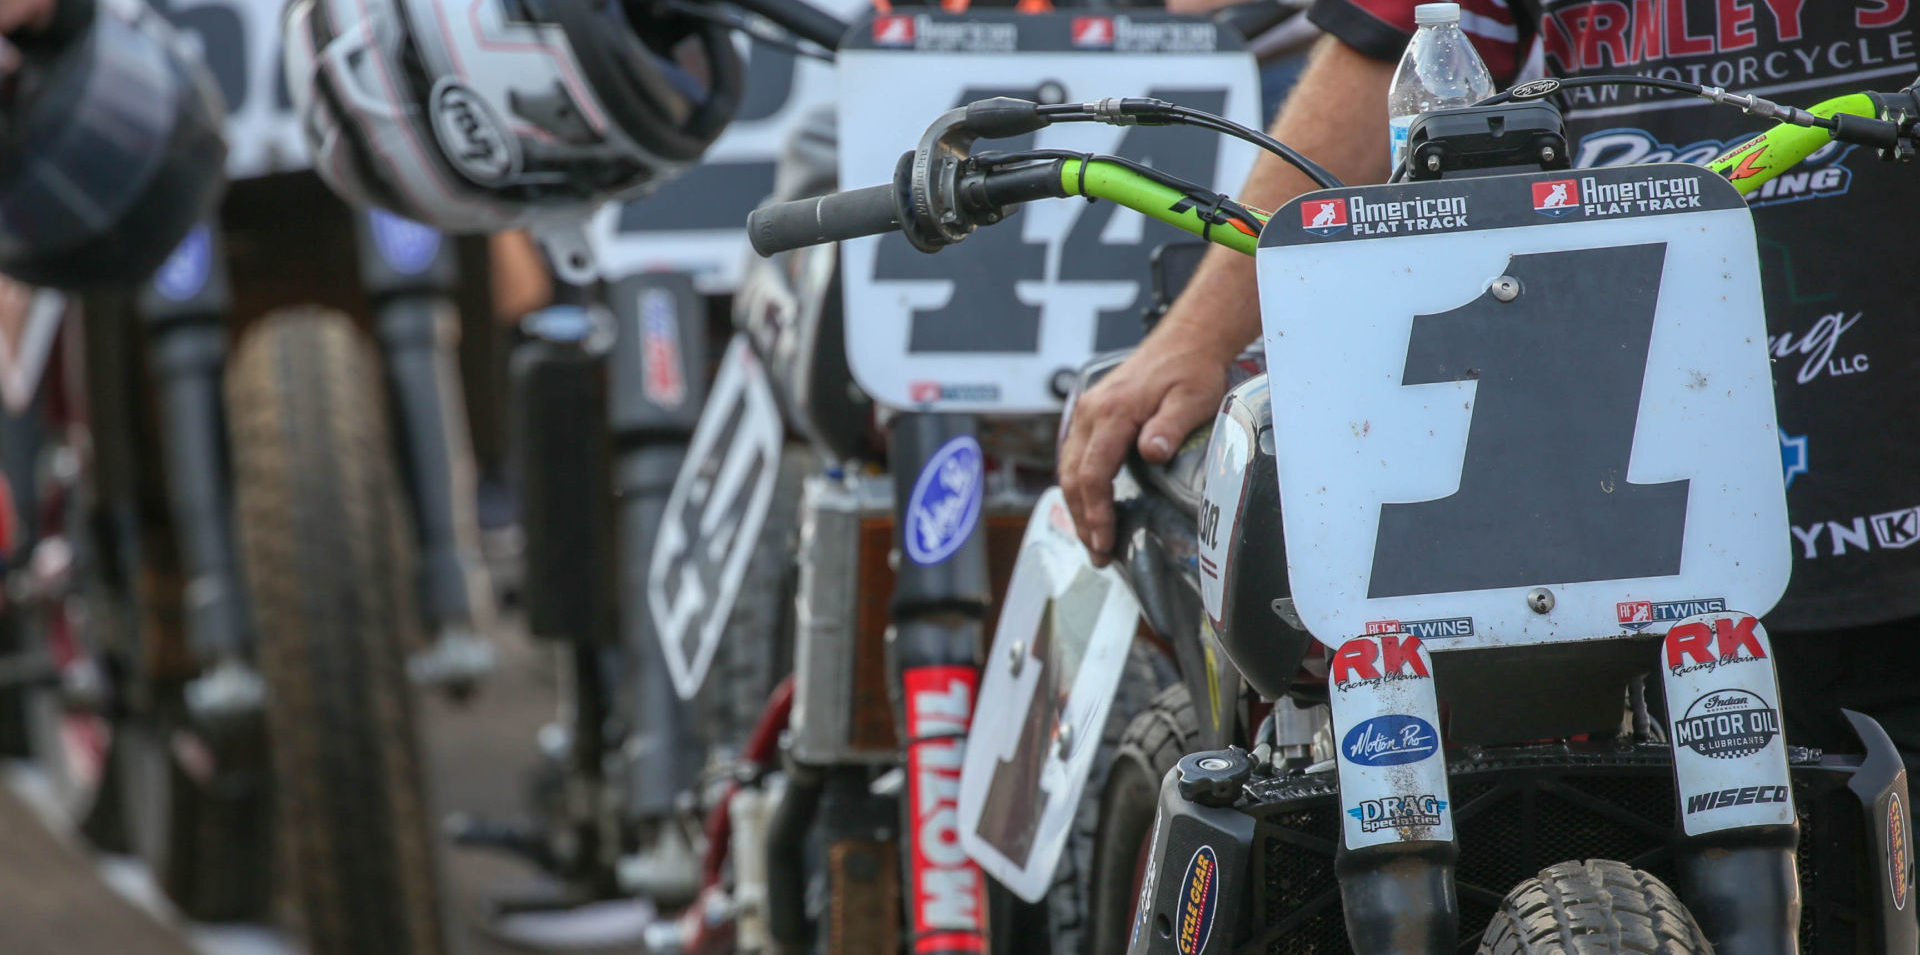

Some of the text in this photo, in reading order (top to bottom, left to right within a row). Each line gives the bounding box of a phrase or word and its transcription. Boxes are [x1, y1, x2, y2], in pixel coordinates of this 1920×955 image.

[1635, 31, 1917, 98] MOTORCYCLE
[1582, 176, 1700, 204] American
[1350, 196, 1467, 223] American
[1584, 196, 1702, 216] FLAT TRACK
[872, 87, 1230, 353] 44
[1352, 215, 1469, 235] FLAT TRACK
[1828, 354, 1869, 376] LLC
[1367, 242, 1691, 599] 1
[1658, 601, 1722, 619] TWINS
[1407, 620, 1471, 638] TWINS
[1666, 616, 1768, 671] RK
[1333, 635, 1431, 685] RK
[1671, 652, 1761, 677] Racing Chain
[1337, 670, 1424, 693] Racing Chain
[1704, 695, 1749, 708] Indian
[1350, 723, 1432, 757] Motion Pro
[1677, 711, 1778, 744] MOTOR OIL
[1698, 735, 1765, 752] & LUBRICANTS
[914, 678, 980, 931] MOTUL
[1360, 795, 1439, 822] DRAG
[1687, 785, 1789, 814] WISECO
[1180, 901, 1199, 955] CYCLE
[1190, 853, 1210, 904] GEAR
